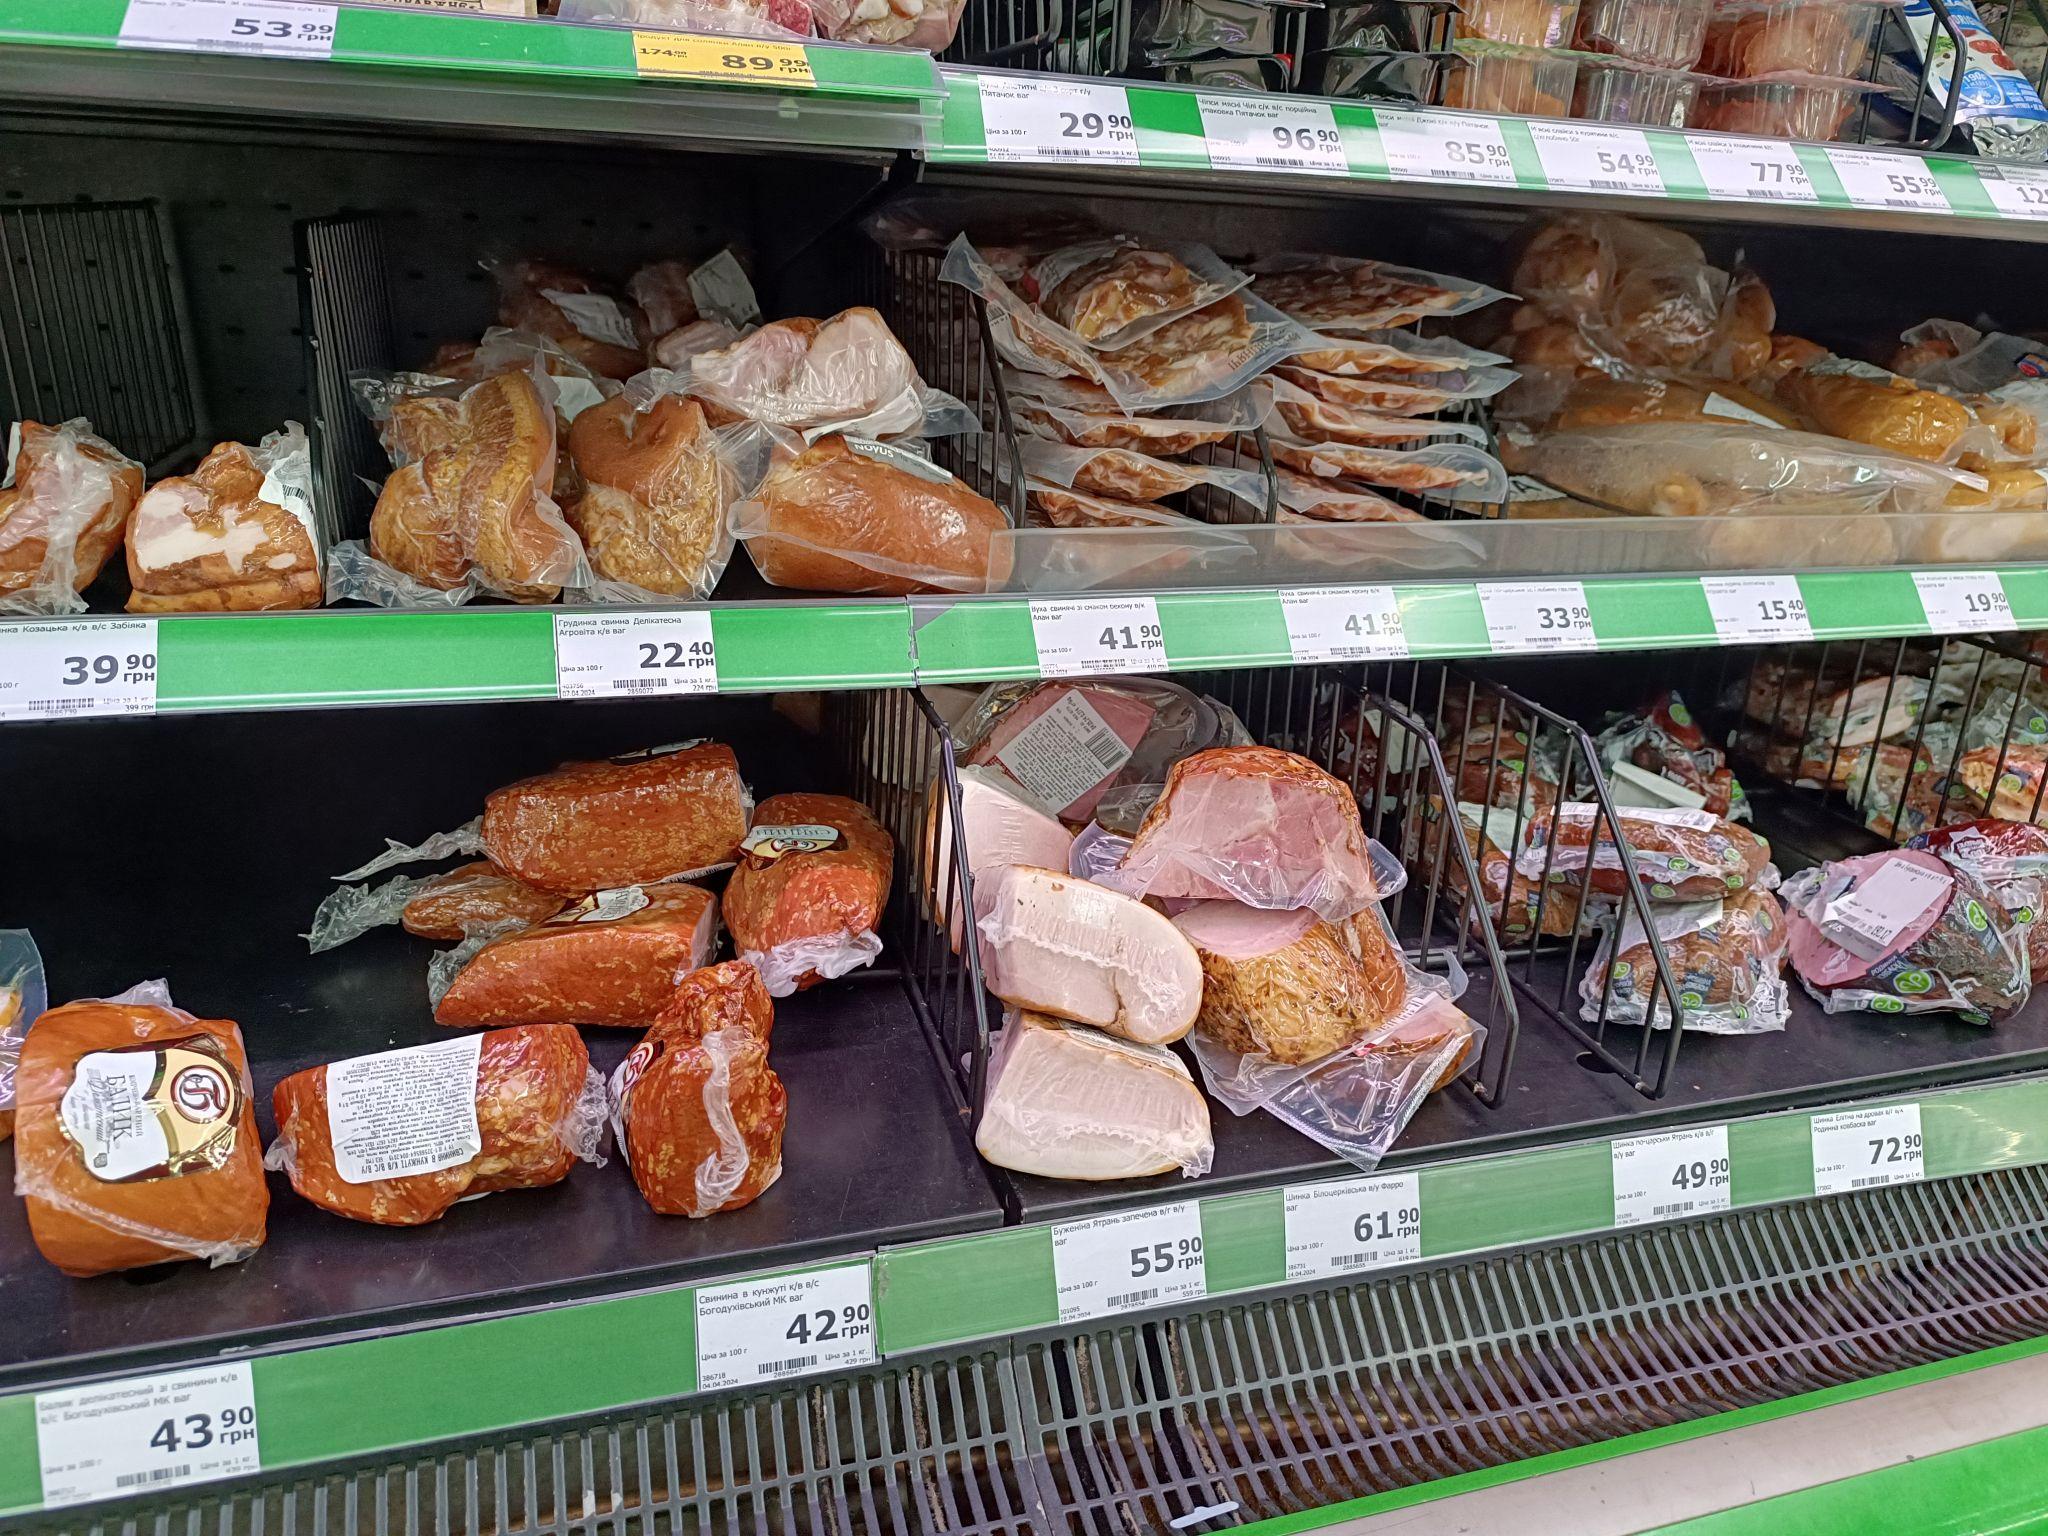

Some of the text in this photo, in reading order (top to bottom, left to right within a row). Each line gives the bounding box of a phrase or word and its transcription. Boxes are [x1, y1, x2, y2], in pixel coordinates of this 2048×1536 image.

[231, 19, 333, 37] 53 99
[297, 33, 331, 41] грн
[639, 48, 674, 56] 174
[721, 54, 806, 70] 89 99
[1060, 112, 1131, 138] 29 90
[1109, 130, 1134, 141] грн
[1272, 126, 1316, 151] 96
[1317, 129, 1339, 143] 90
[1319, 143, 1342, 153] грн
[1445, 141, 1507, 164] 85 90
[1488, 157, 1510, 167] грн
[1598, 151, 1654, 174] 54 99
[1638, 167, 1658, 176] грн
[1750, 162, 1804, 182] 77 99
[1790, 176, 1809, 184] грн
[1887, 174, 1936, 194] 55 99
[1924, 188, 1942, 196] грн
[855, 443, 894, 458] NOVUS
[1965, 593, 2006, 612] 19 90
[1994, 603, 2009, 612] грн
[1758, 600, 1804, 620] 15 40
[1790, 611, 1806, 621] грн
[558, 619, 597, 628] Грудинка
[633, 617, 682, 626] Делікатесна
[1345, 613, 1400, 636] 41 90
[1537, 606, 1589, 629] 33 90
[1573, 620, 1592, 629] грн
[22, 625, 68, 633] Козацька
[72, 624, 87, 632] к/в
[92, 622, 107, 630] в/с
[111, 621, 146, 630] Забіяка
[559, 628, 596, 637] Агровіта
[597, 628, 611, 636] к/в
[1382, 626, 1403, 636] грн
[1099, 625, 1161, 650] 41 90
[1141, 639, 1163, 650] грн
[639, 641, 714, 669] 22 40
[62, 654, 156, 685] 39 90
[688, 657, 714, 669] грн
[123, 671, 155, 684] грн
[1813, 1116, 1834, 1125] Шинка
[1814, 1123, 1839, 1134] Родинна
[1613, 1141, 1634, 1150] Шинка
[1671, 1133, 1693, 1142] Ятрань
[1868, 1134, 1921, 1165] 72 90
[1904, 1150, 1922, 1161] грн
[401, 1157, 429, 1169] КУНЖУТІ
[431, 1155, 436, 1163] В
[1671, 1158, 1729, 1190] 49 90
[1710, 1175, 1729, 1187] грн
[1286, 1181, 1403, 1201] Шинка Білоцерківська в/у Фарро
[1286, 1204, 1299, 1212] ваг
[1053, 1205, 1185, 1236] Буженіна Ятрань запечена в/г в/у
[1354, 1207, 1419, 1242] 61 90
[1397, 1225, 1419, 1238] грн
[1054, 1237, 1067, 1246] ваг
[1130, 1236, 1202, 1278] 55 90
[1178, 1256, 1203, 1269] грн
[699, 1291, 738, 1304] Свинина
[752, 1283, 786, 1297] кунжуті
[789, 1281, 803, 1291] к/в
[806, 1279, 819, 1289] в/с
[1058, 1285, 1072, 1294] Ціна
[1082, 1281, 1093, 1289] 100
[699, 1293, 804, 1316] Богодухівський МК ваг
[786, 1304, 870, 1345] 42 90
[842, 1323, 870, 1338] грн
[701, 1352, 717, 1361] Ціна
[719, 1351, 727, 1359] за
[729, 1348, 742, 1356] 100
[39, 1372, 238, 1411] Балик делікатесний зі свинини к/в
[703, 1379, 738, 1390] 04.04.2024
[64, 1399, 151, 1420] Богодухівський
[154, 1394, 171, 1406] МК
[174, 1393, 192, 1404] ваг
[151, 1406, 255, 1453] 43 90
[220, 1428, 255, 1445] грн
